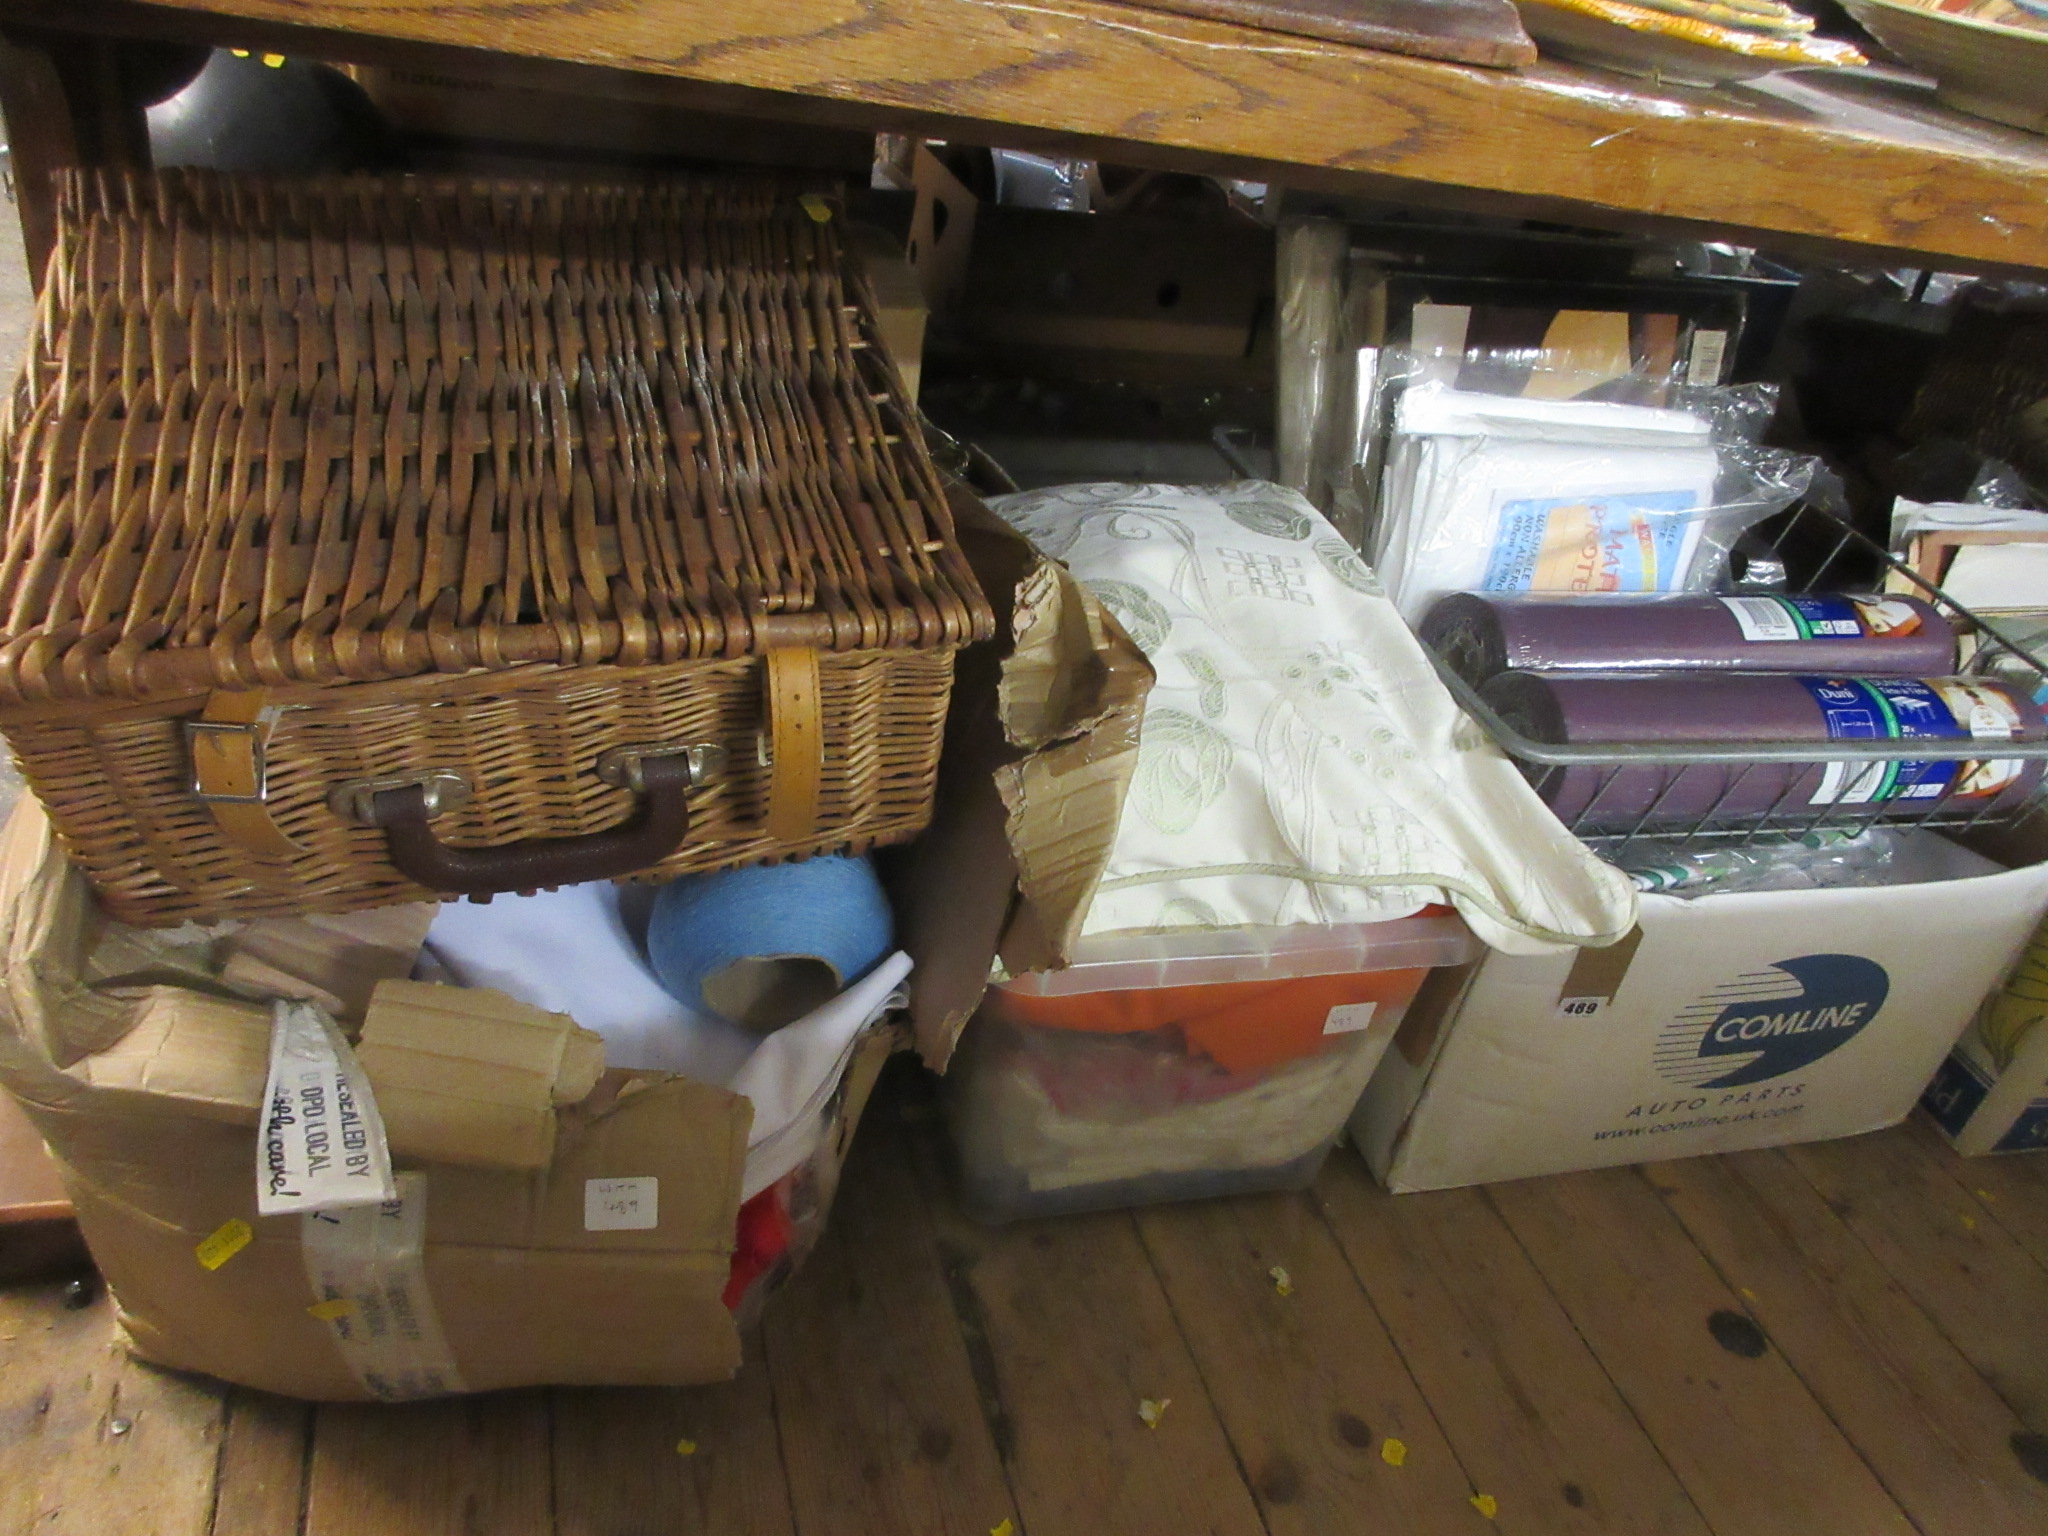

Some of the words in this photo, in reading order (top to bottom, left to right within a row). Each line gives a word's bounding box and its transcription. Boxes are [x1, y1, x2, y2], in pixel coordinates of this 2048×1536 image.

[1817, 687, 1856, 699] Duni
[1714, 1002, 1868, 1042] COMLINE
[300, 1086, 326, 1118] DPD
[1626, 1098, 1706, 1118] AUTO
[1719, 1084, 1806, 1106] PARTS
[304, 1121, 331, 1178] LOCAL
[345, 1155, 370, 1177] BY
[267, 1139, 302, 1197] care!
